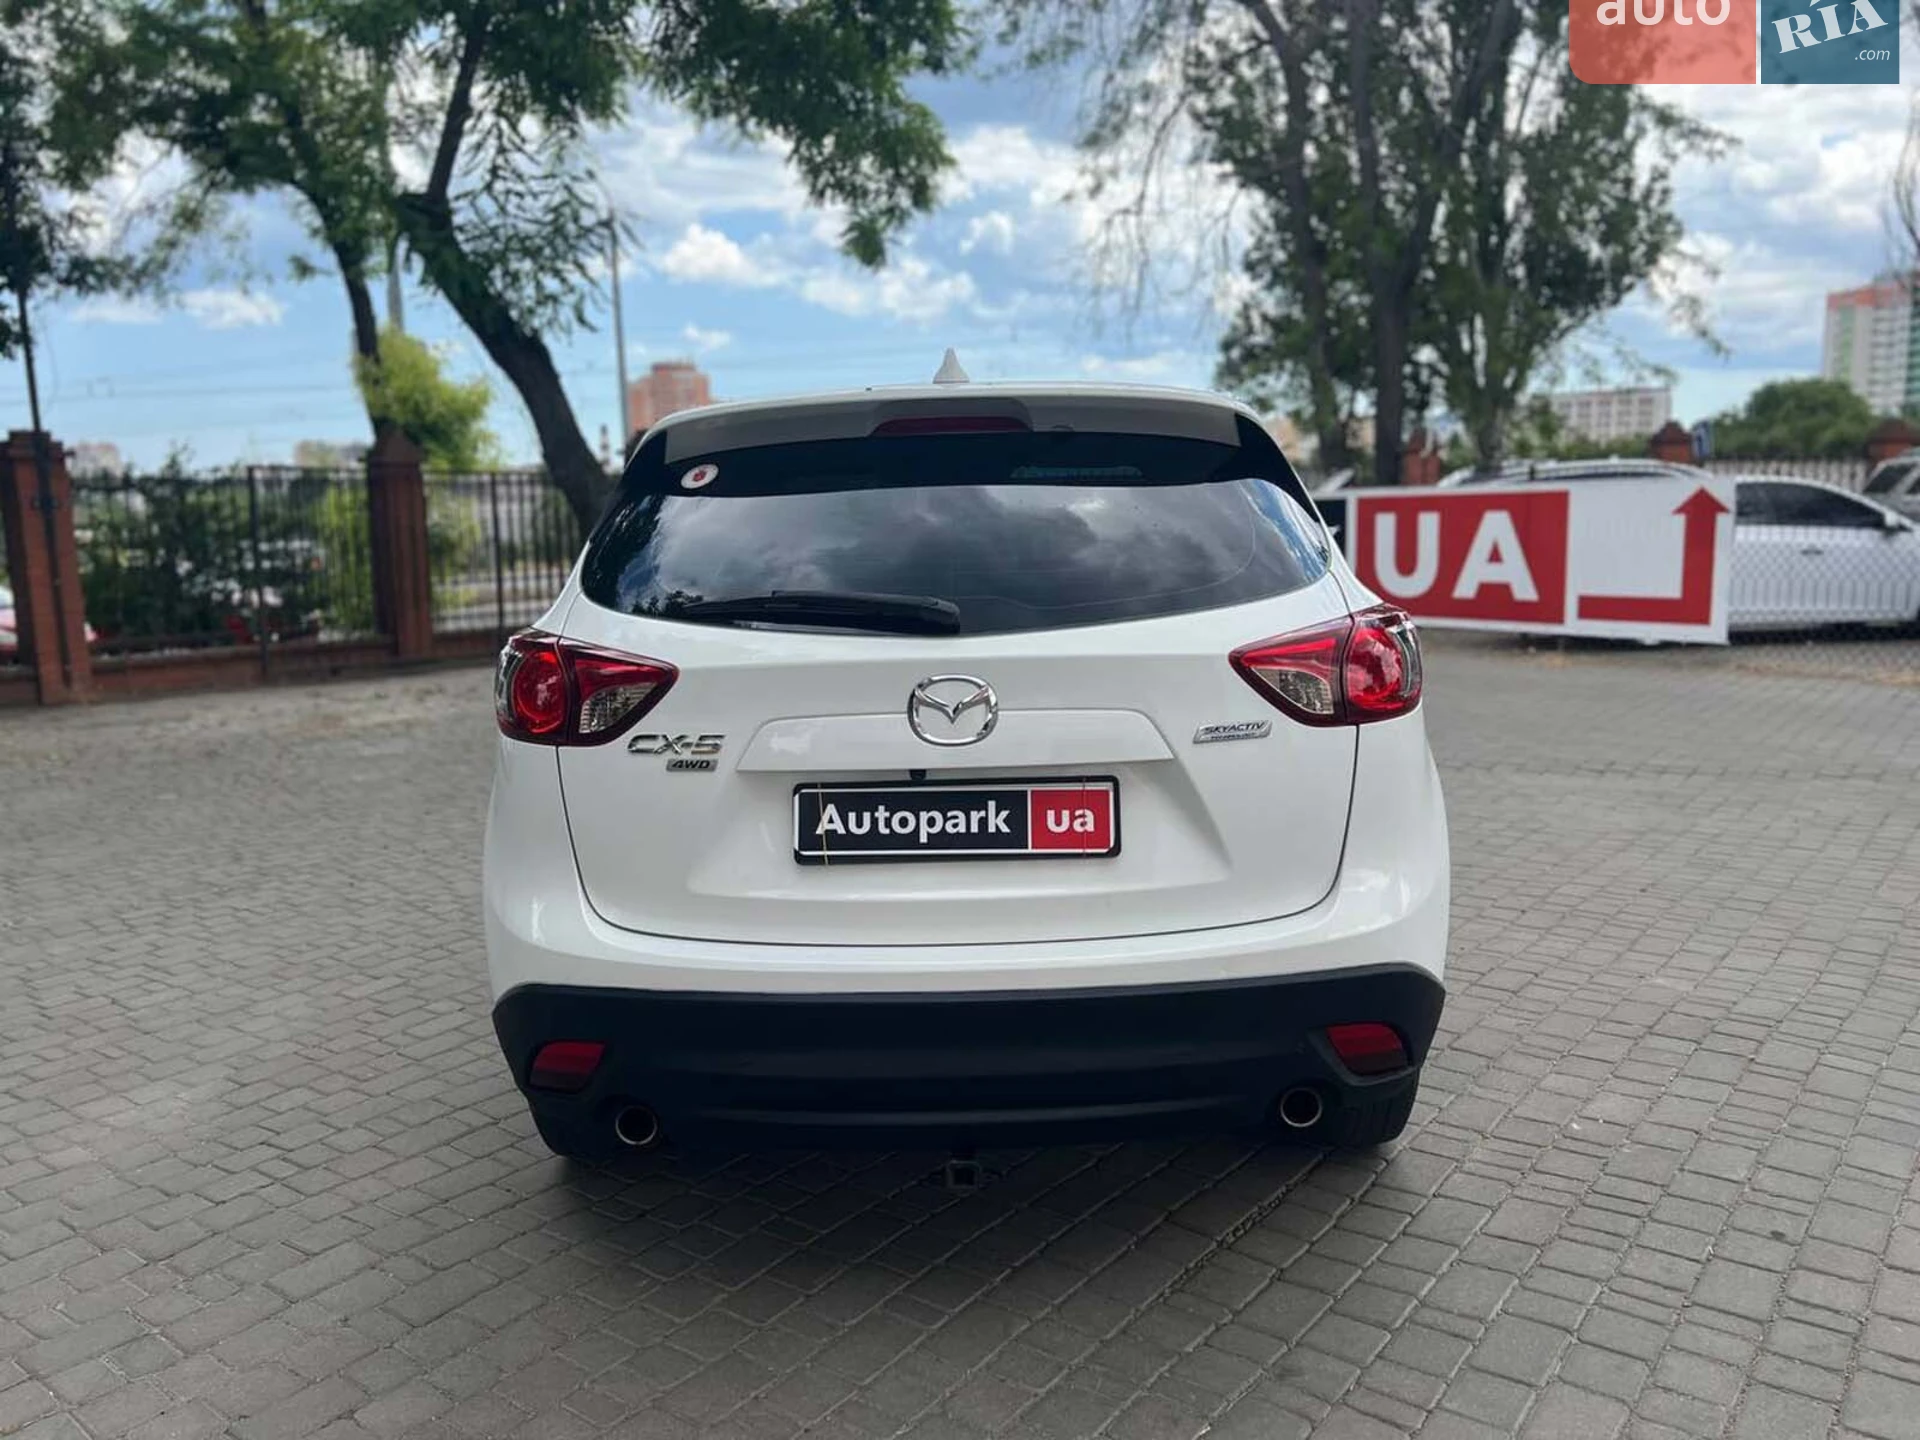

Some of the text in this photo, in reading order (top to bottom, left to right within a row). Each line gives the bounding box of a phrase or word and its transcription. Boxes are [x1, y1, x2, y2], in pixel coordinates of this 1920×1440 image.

[1374, 510, 1540, 602] UA
[1200, 722, 1265, 735] SKYACTIV
[627, 734, 725, 755] CX-5
[671, 760, 711, 769] 4WD
[816, 801, 1095, 843] Autopark ua
